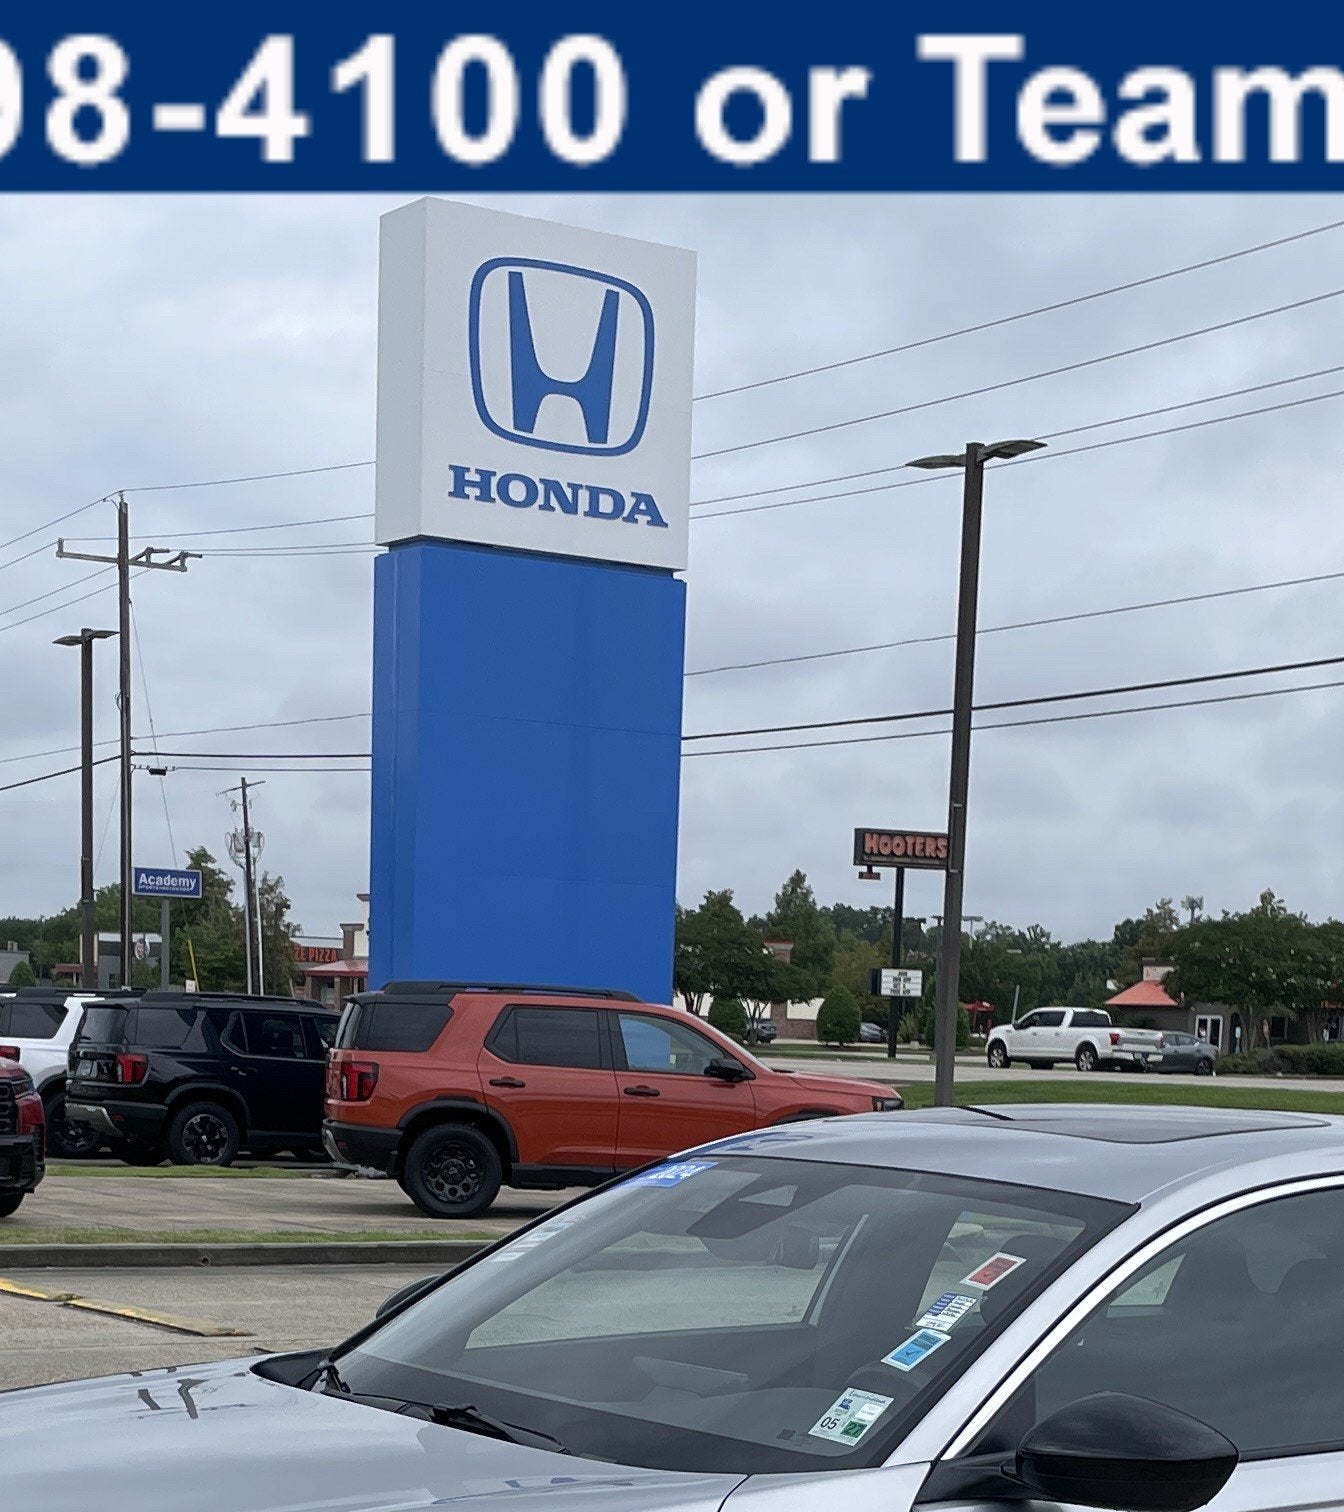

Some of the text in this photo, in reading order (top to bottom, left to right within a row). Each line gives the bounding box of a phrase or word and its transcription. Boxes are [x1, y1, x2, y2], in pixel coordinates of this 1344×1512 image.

[448, 464, 668, 529] HONDA
[864, 832, 948, 858] HOOTERS
[138, 873, 197, 890] Academy
[820, 1417, 841, 1430] 05
